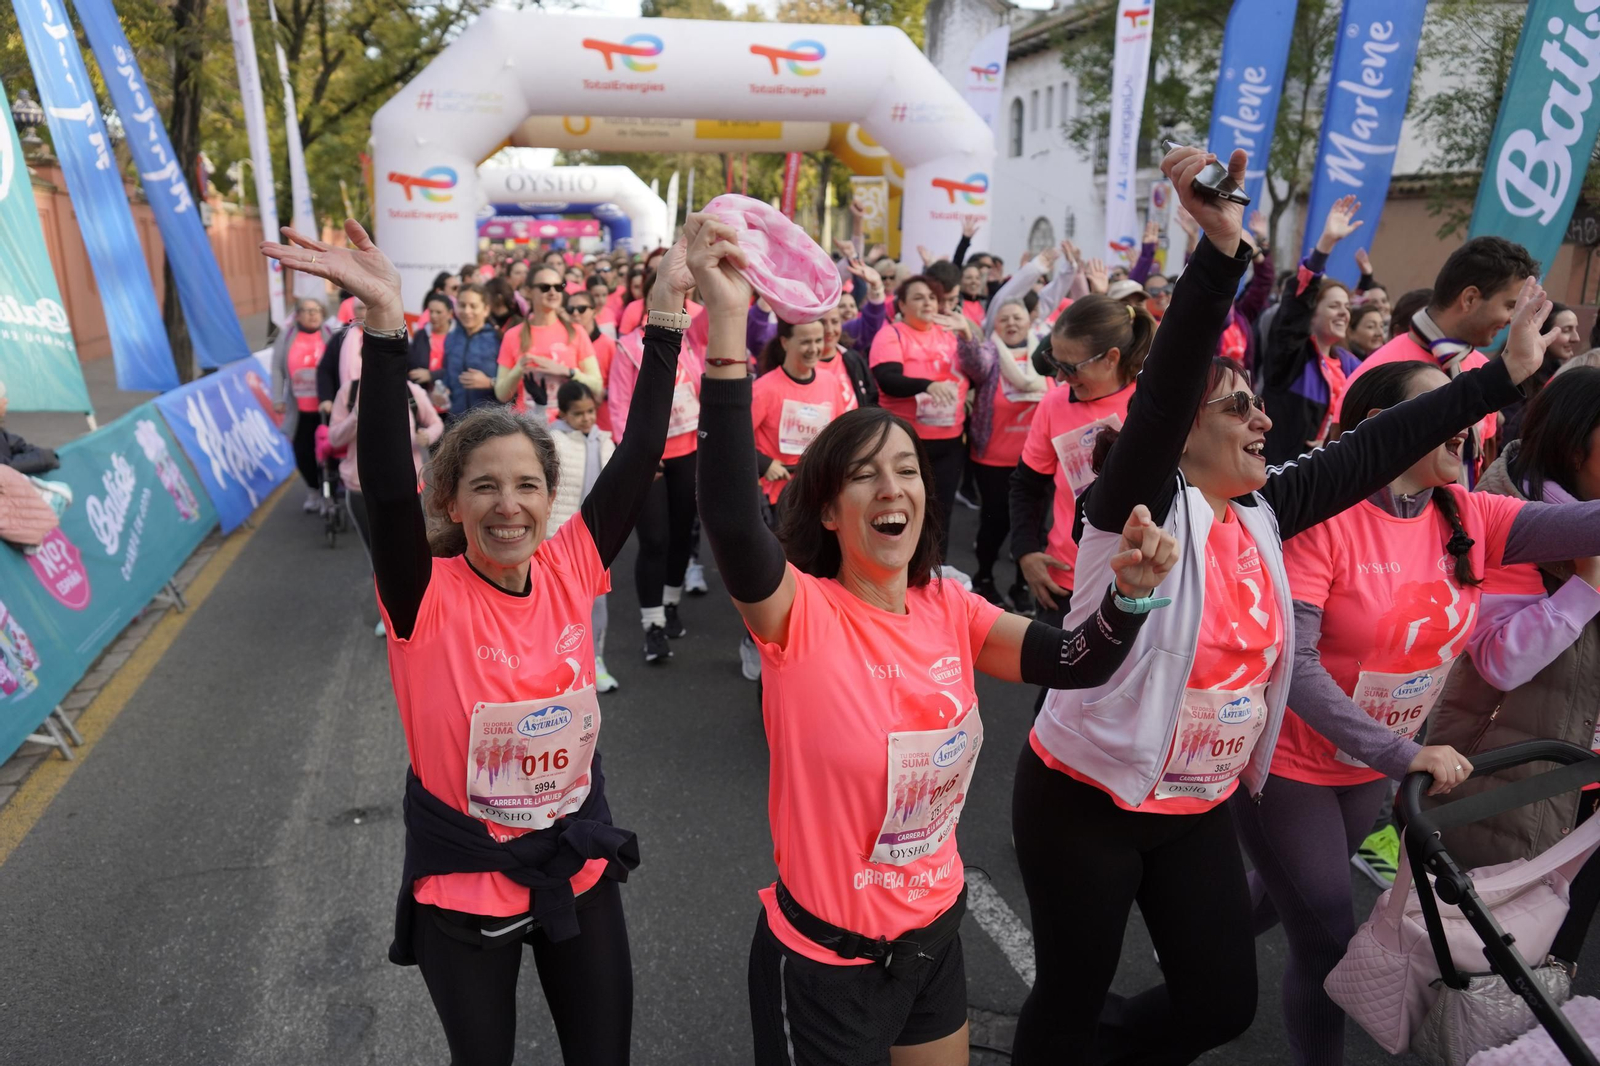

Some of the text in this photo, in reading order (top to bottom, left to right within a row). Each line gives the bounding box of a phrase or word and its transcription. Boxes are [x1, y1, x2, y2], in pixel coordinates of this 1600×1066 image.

[582, 79, 665, 93] TotalEnergies
[749, 83, 826, 97] TotalEnergies
[1325, 20, 1399, 188] Marlene
[1496, 0, 1600, 227] Bati
[505, 173, 598, 193] OYSHO
[387, 208, 459, 221] TotalEnergies
[1364, 690, 1389, 698] SUMA
[1192, 710, 1216, 720] SUMA
[1386, 704, 1423, 726] 016
[483, 727, 514, 735] SUMA
[1211, 736, 1245, 758] 016
[521, 748, 569, 777] 016
[901, 759, 930, 768] SUMA
[534, 780, 556, 794] 5994
[930, 773, 959, 805] 016
[1168, 785, 1207, 794] OYSHO
[490, 797, 521, 806] CARRERA
[524, 797, 533, 805] DE
[541, 792, 562, 803] MUJER
[485, 807, 532, 821] OYSHO
[898, 830, 925, 841] CARRERA
[889, 842, 930, 858] OYSHO
